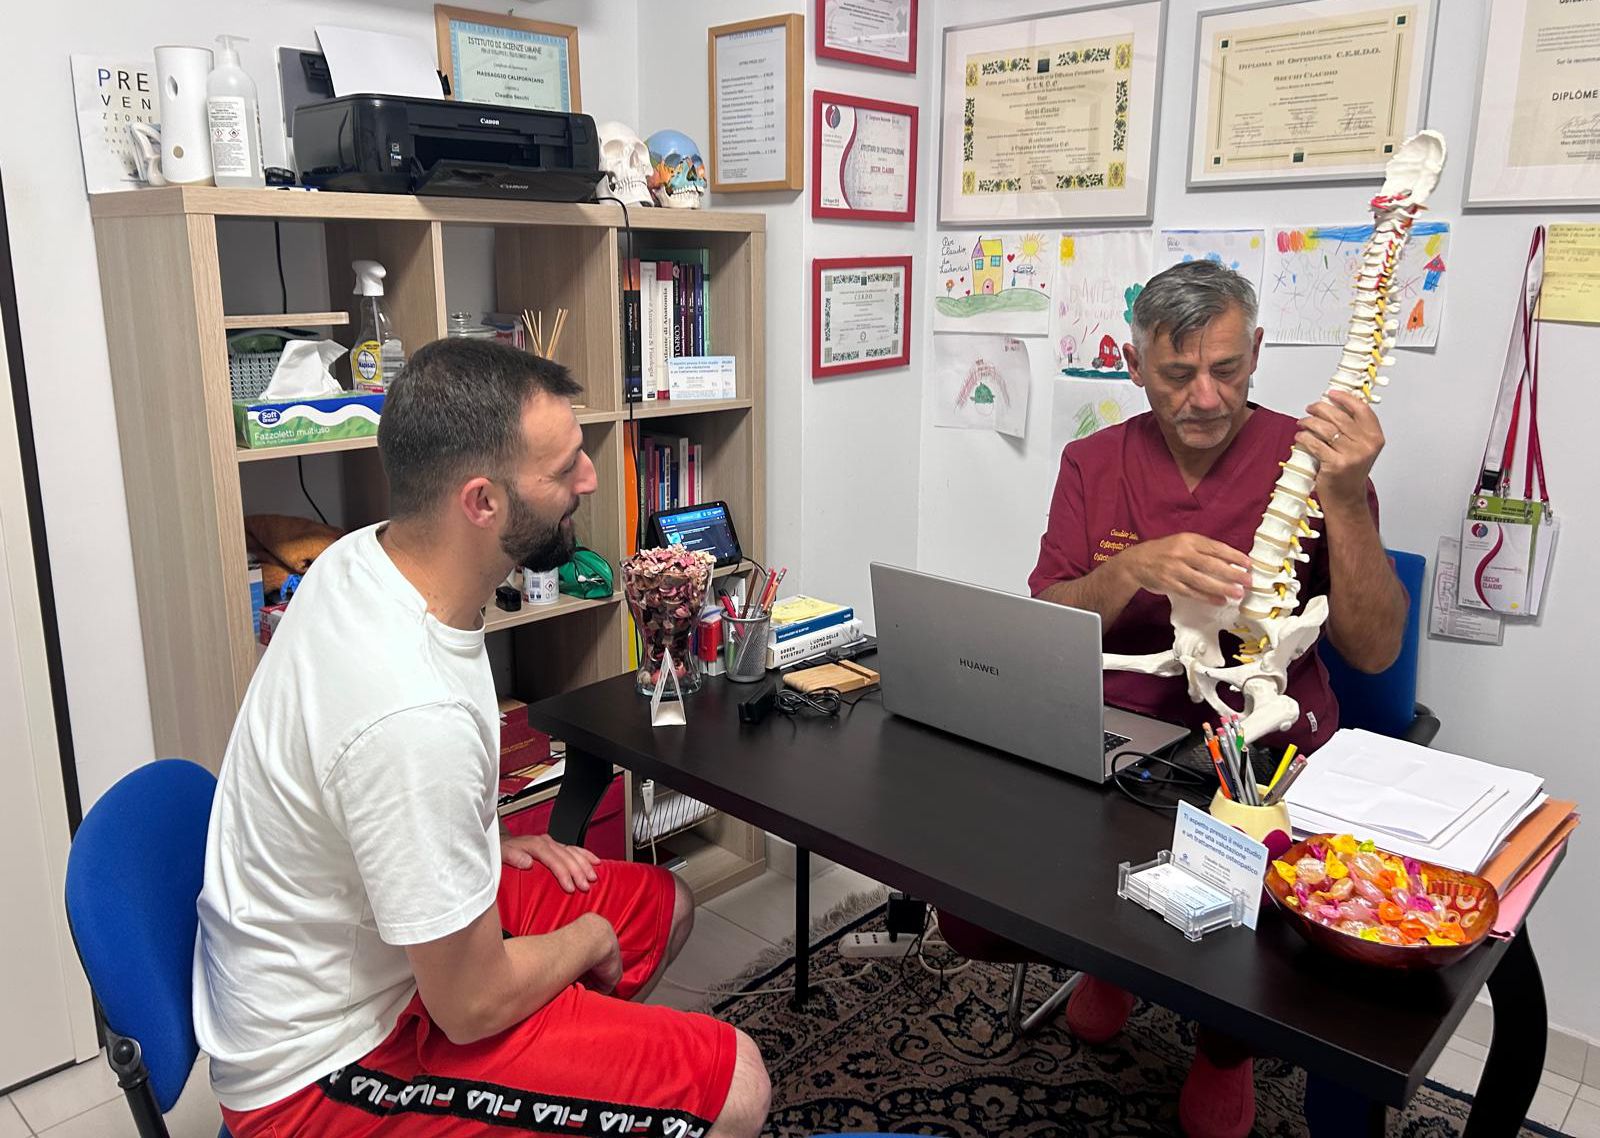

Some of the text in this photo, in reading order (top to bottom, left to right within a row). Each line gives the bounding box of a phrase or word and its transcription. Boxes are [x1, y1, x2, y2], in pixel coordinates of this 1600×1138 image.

[480, 117, 499, 125] Canon
[262, 411, 277, 419] Soft
[254, 426, 330, 441] Fazzoletti multiuso
[959, 657, 999, 676] HUAWEI
[1183, 812, 1189, 820] Ti
[1189, 817, 1209, 831] aspetto
[1209, 827, 1227, 841] presso
[1232, 840, 1243, 850] mio
[1243, 846, 1262, 860] studio
[1194, 828, 1246, 860] per una valutazione
[1194, 835, 1225, 857] trattamento
[1225, 854, 1258, 876] osteopatico
[351, 1076, 401, 1107] FILA
[400, 1084, 455, 1107] FILA
[467, 1090, 521, 1119] FILA
[533, 1103, 588, 1127] FILA
[599, 1111, 652, 1133] FILA
